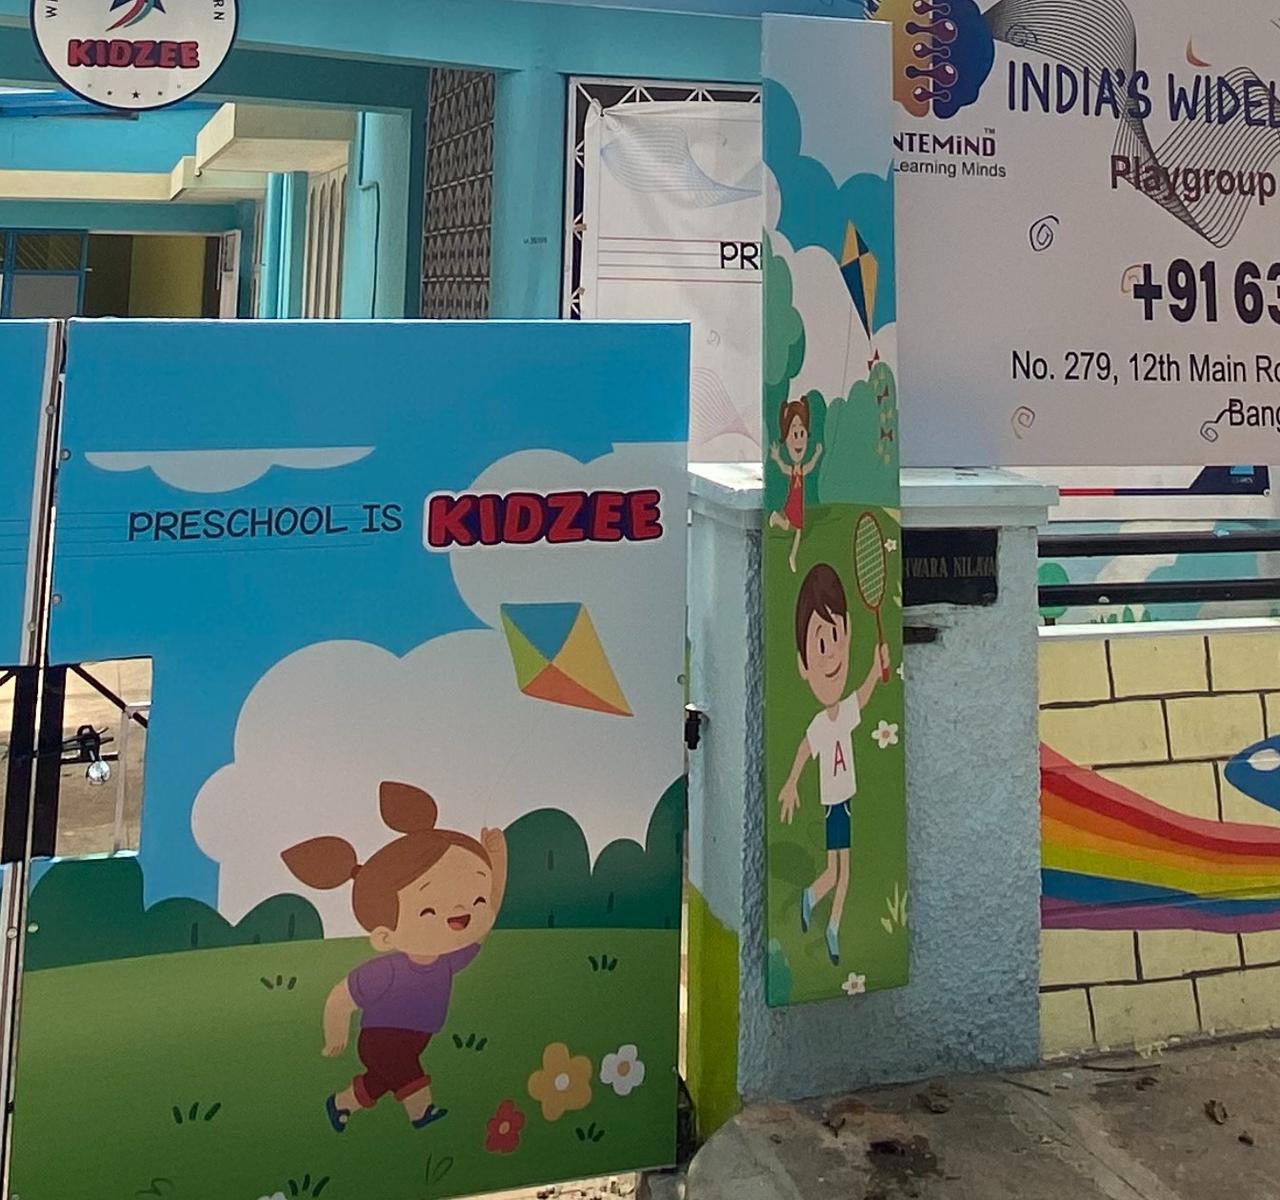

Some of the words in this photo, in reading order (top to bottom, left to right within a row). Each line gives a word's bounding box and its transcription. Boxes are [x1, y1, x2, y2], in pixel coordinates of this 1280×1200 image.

[67, 39, 200, 69] KIDZEE
[1008, 60, 1152, 120] INDIA'S
[893, 132, 996, 157] NTEMiND
[961, 161, 1007, 178] Minds
[1111, 155, 1276, 206] Playgroup
[1133, 259, 1217, 323] +91
[1011, 350, 1055, 380] No.
[1064, 352, 1118, 386] 279,
[1129, 352, 1181, 382] 12th
[1189, 353, 1247, 383] Main
[128, 505, 348, 542] PRESCHOOL
[361, 503, 402, 533] IS
[428, 489, 662, 548] KIDZEE
